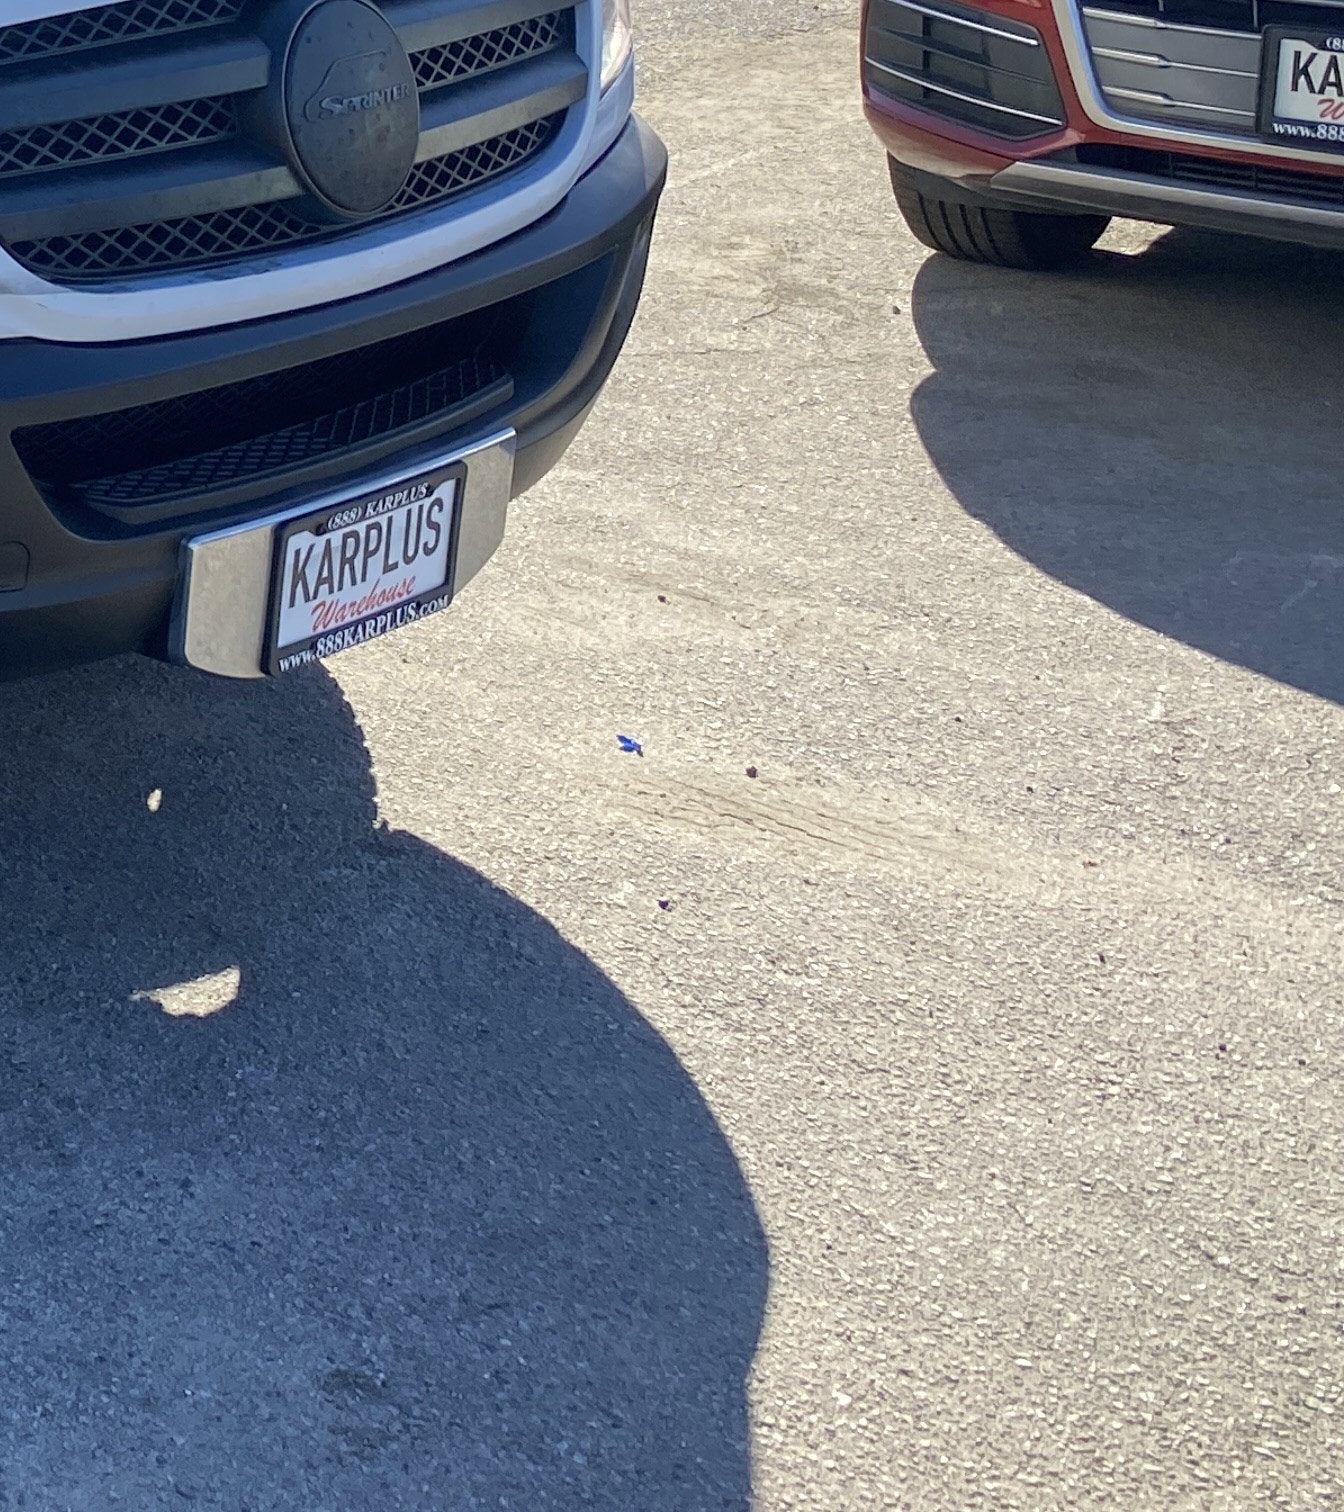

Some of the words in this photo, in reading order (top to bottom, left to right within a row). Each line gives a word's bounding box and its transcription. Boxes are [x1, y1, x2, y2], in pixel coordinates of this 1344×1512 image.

[365, 482, 429, 518] KARPLUS
[288, 497, 444, 609] KARPLUS
[311, 575, 417, 633] Warehouse
